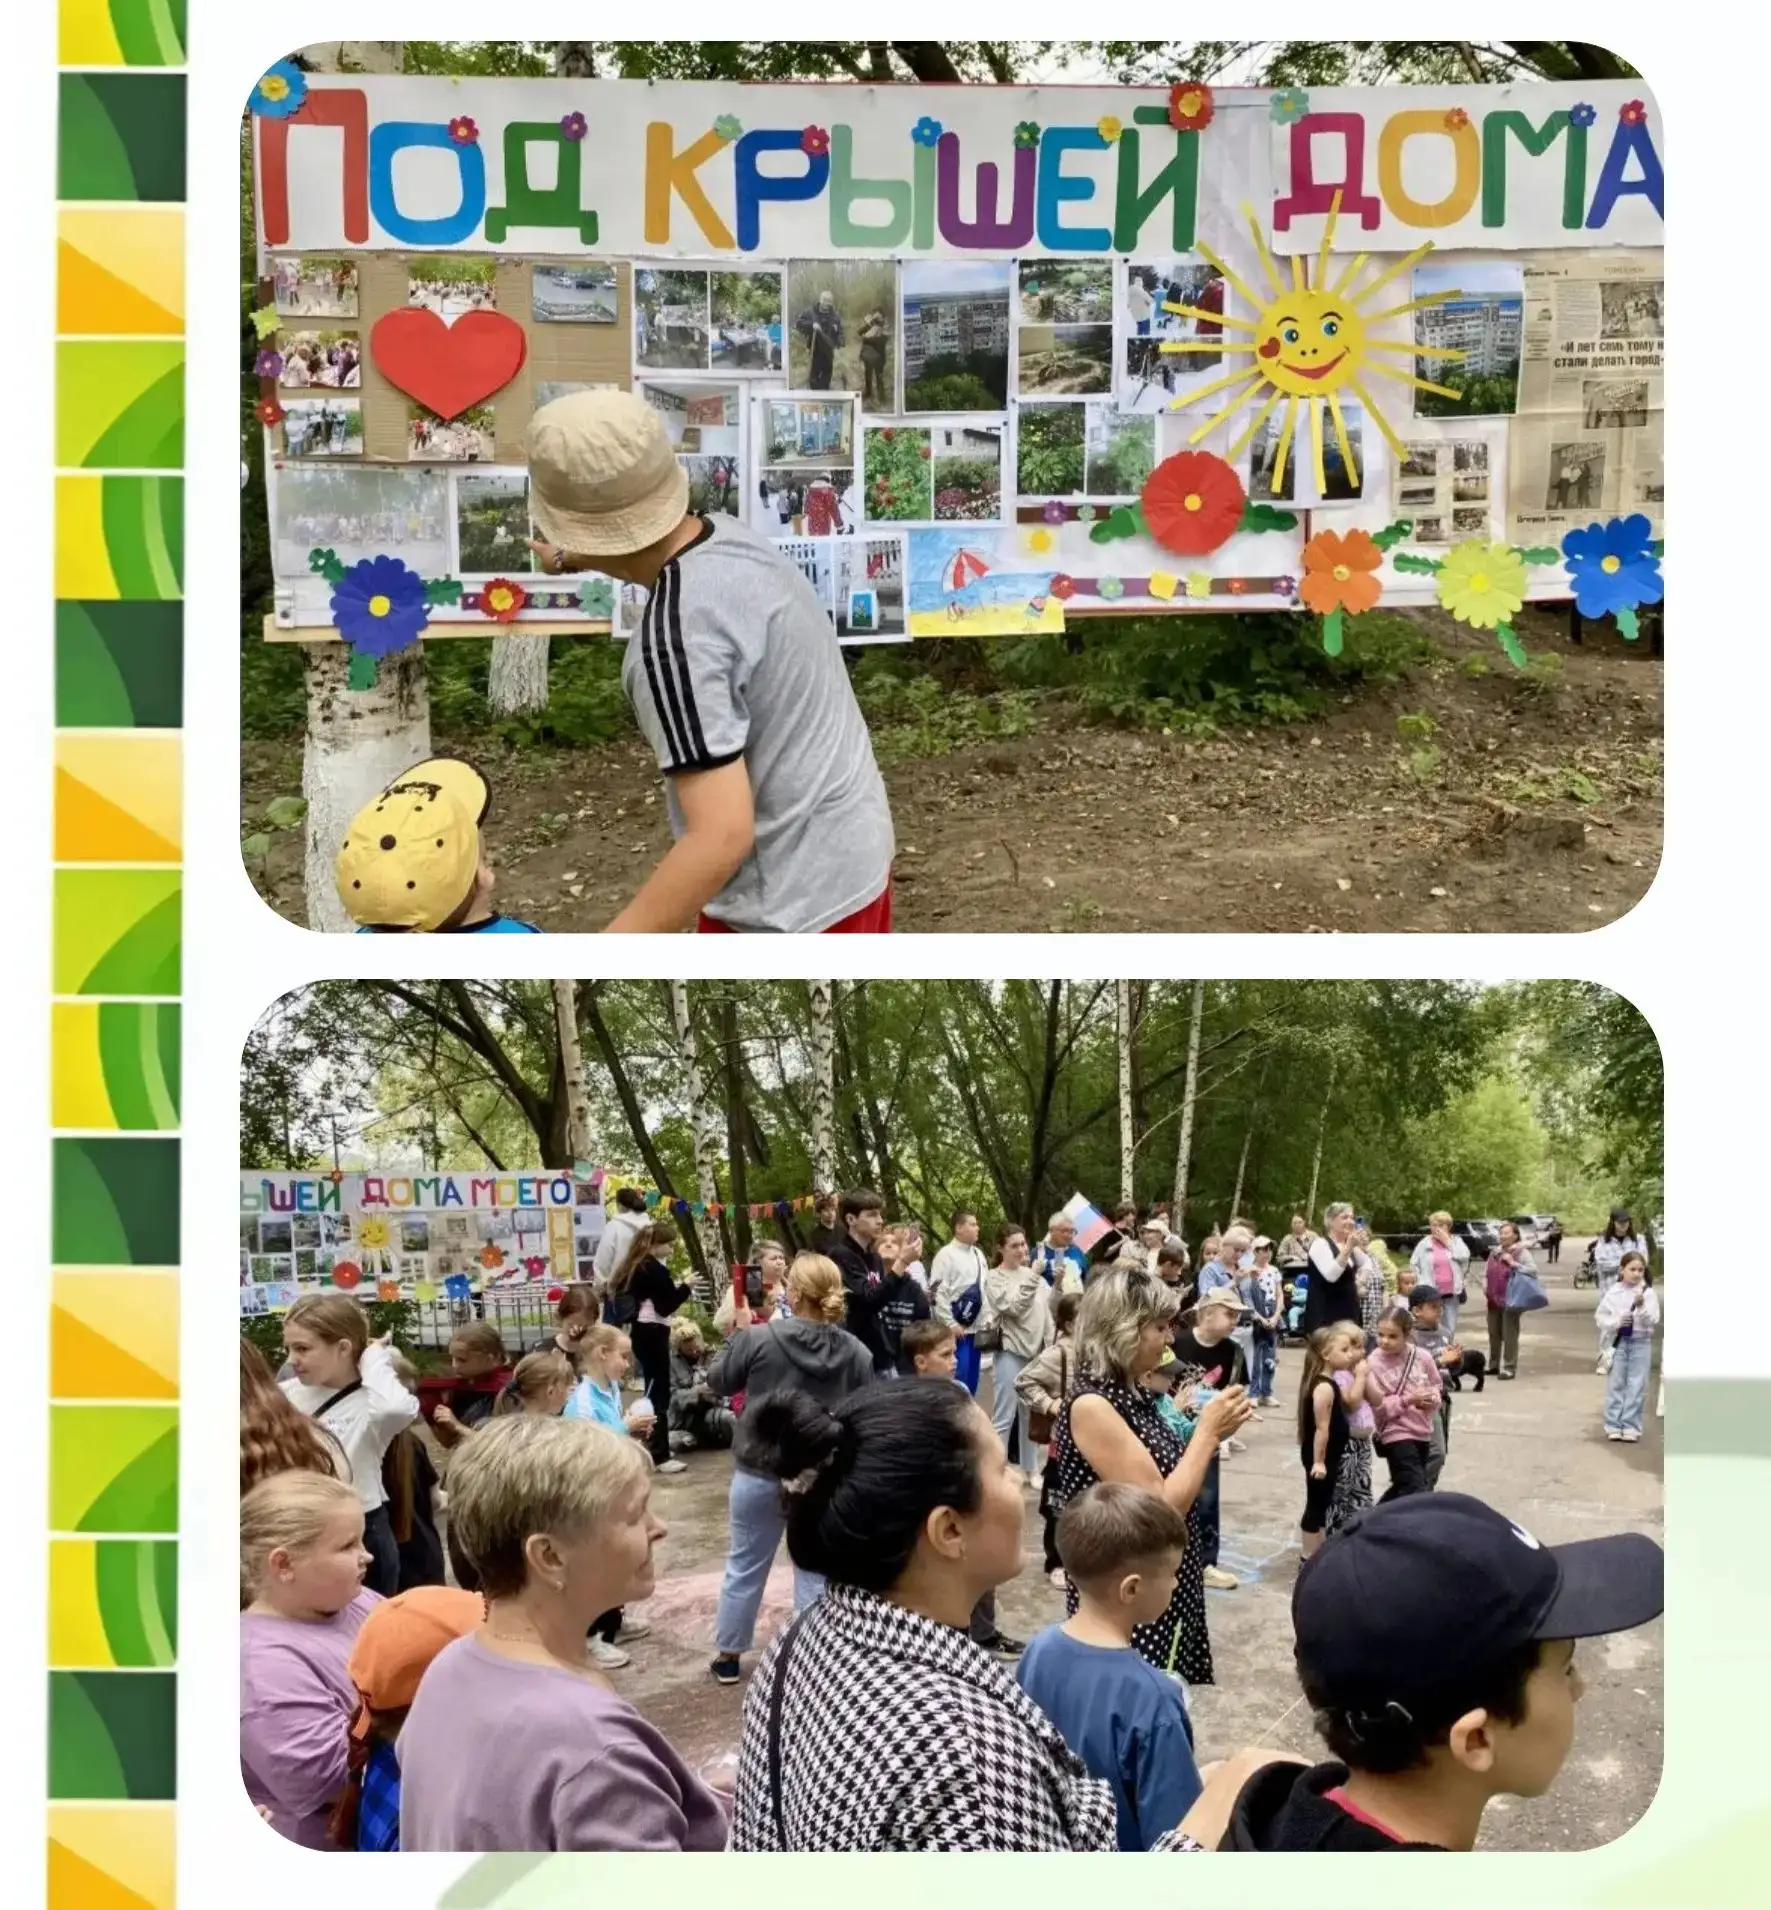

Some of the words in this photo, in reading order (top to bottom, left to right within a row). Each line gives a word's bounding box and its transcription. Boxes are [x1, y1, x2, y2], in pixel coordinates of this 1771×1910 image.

[644, 104, 1200, 252] КРЫШЕЙ
[1273, 109, 1664, 230] ДОМА
[1577, 340, 1596, 352] лет
[1598, 340, 1624, 352] семь
[1627, 340, 1654, 352] тому
[1554, 356, 1588, 368] стали
[1591, 356, 1626, 368] делать
[361, 1176, 464, 1208] ДОМА
[471, 1176, 571, 1207] МОЕГО
